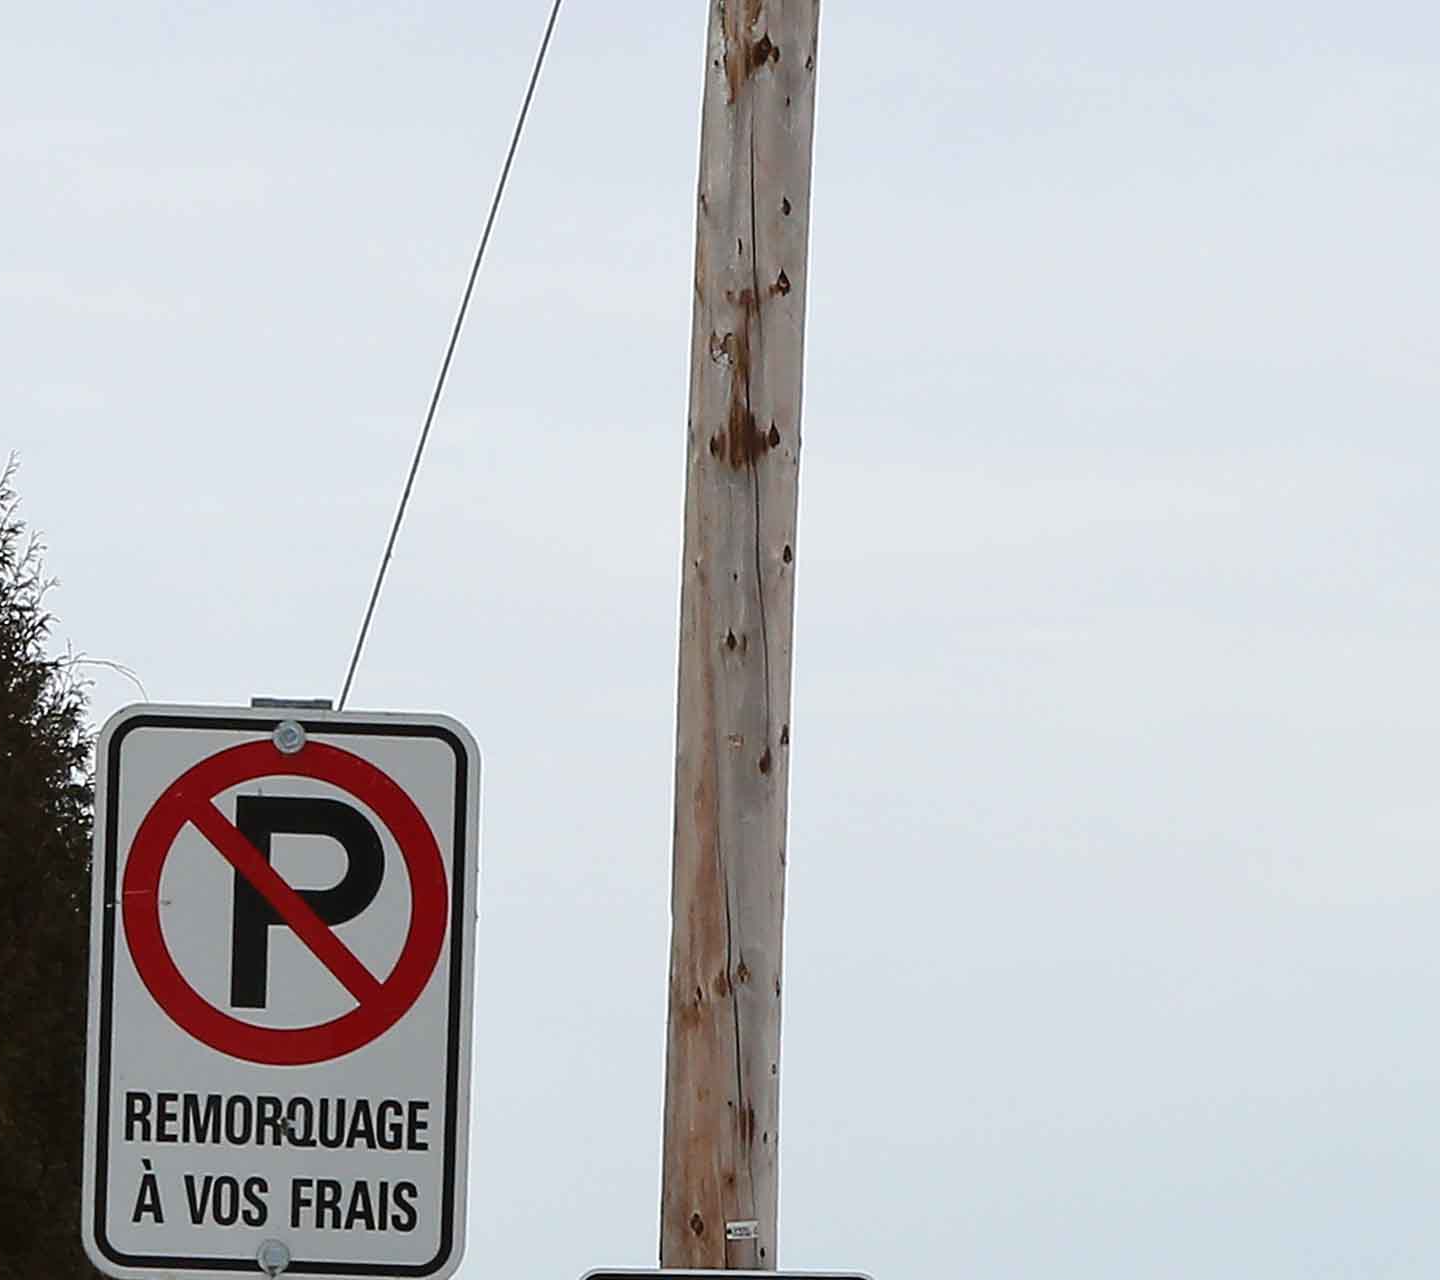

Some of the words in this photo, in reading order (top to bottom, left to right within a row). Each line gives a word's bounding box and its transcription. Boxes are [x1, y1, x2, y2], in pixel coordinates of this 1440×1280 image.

[231, 795, 385, 1009] P
[124, 1091, 430, 1151] REMORQUAGE
[131, 1158, 165, 1224] À
[184, 1174, 269, 1227] VOS
[290, 1178, 419, 1232] FRAIS
